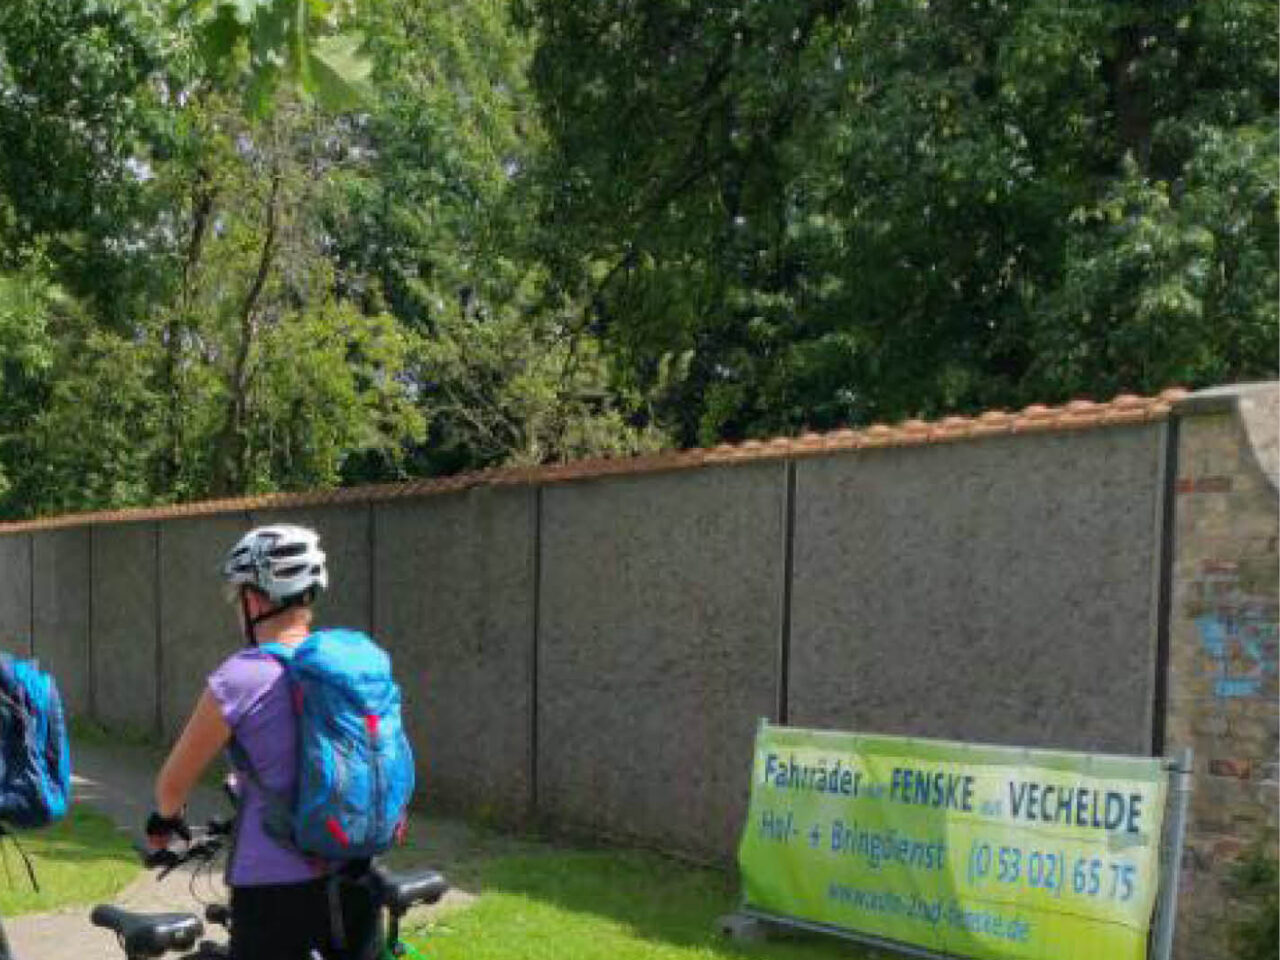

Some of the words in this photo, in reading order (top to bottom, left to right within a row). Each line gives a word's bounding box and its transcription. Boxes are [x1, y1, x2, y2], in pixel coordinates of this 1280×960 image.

[764, 753, 864, 798] Fahrräder
[890, 767, 975, 812] FENSKE
[1009, 781, 1142, 833] VECHELDE
